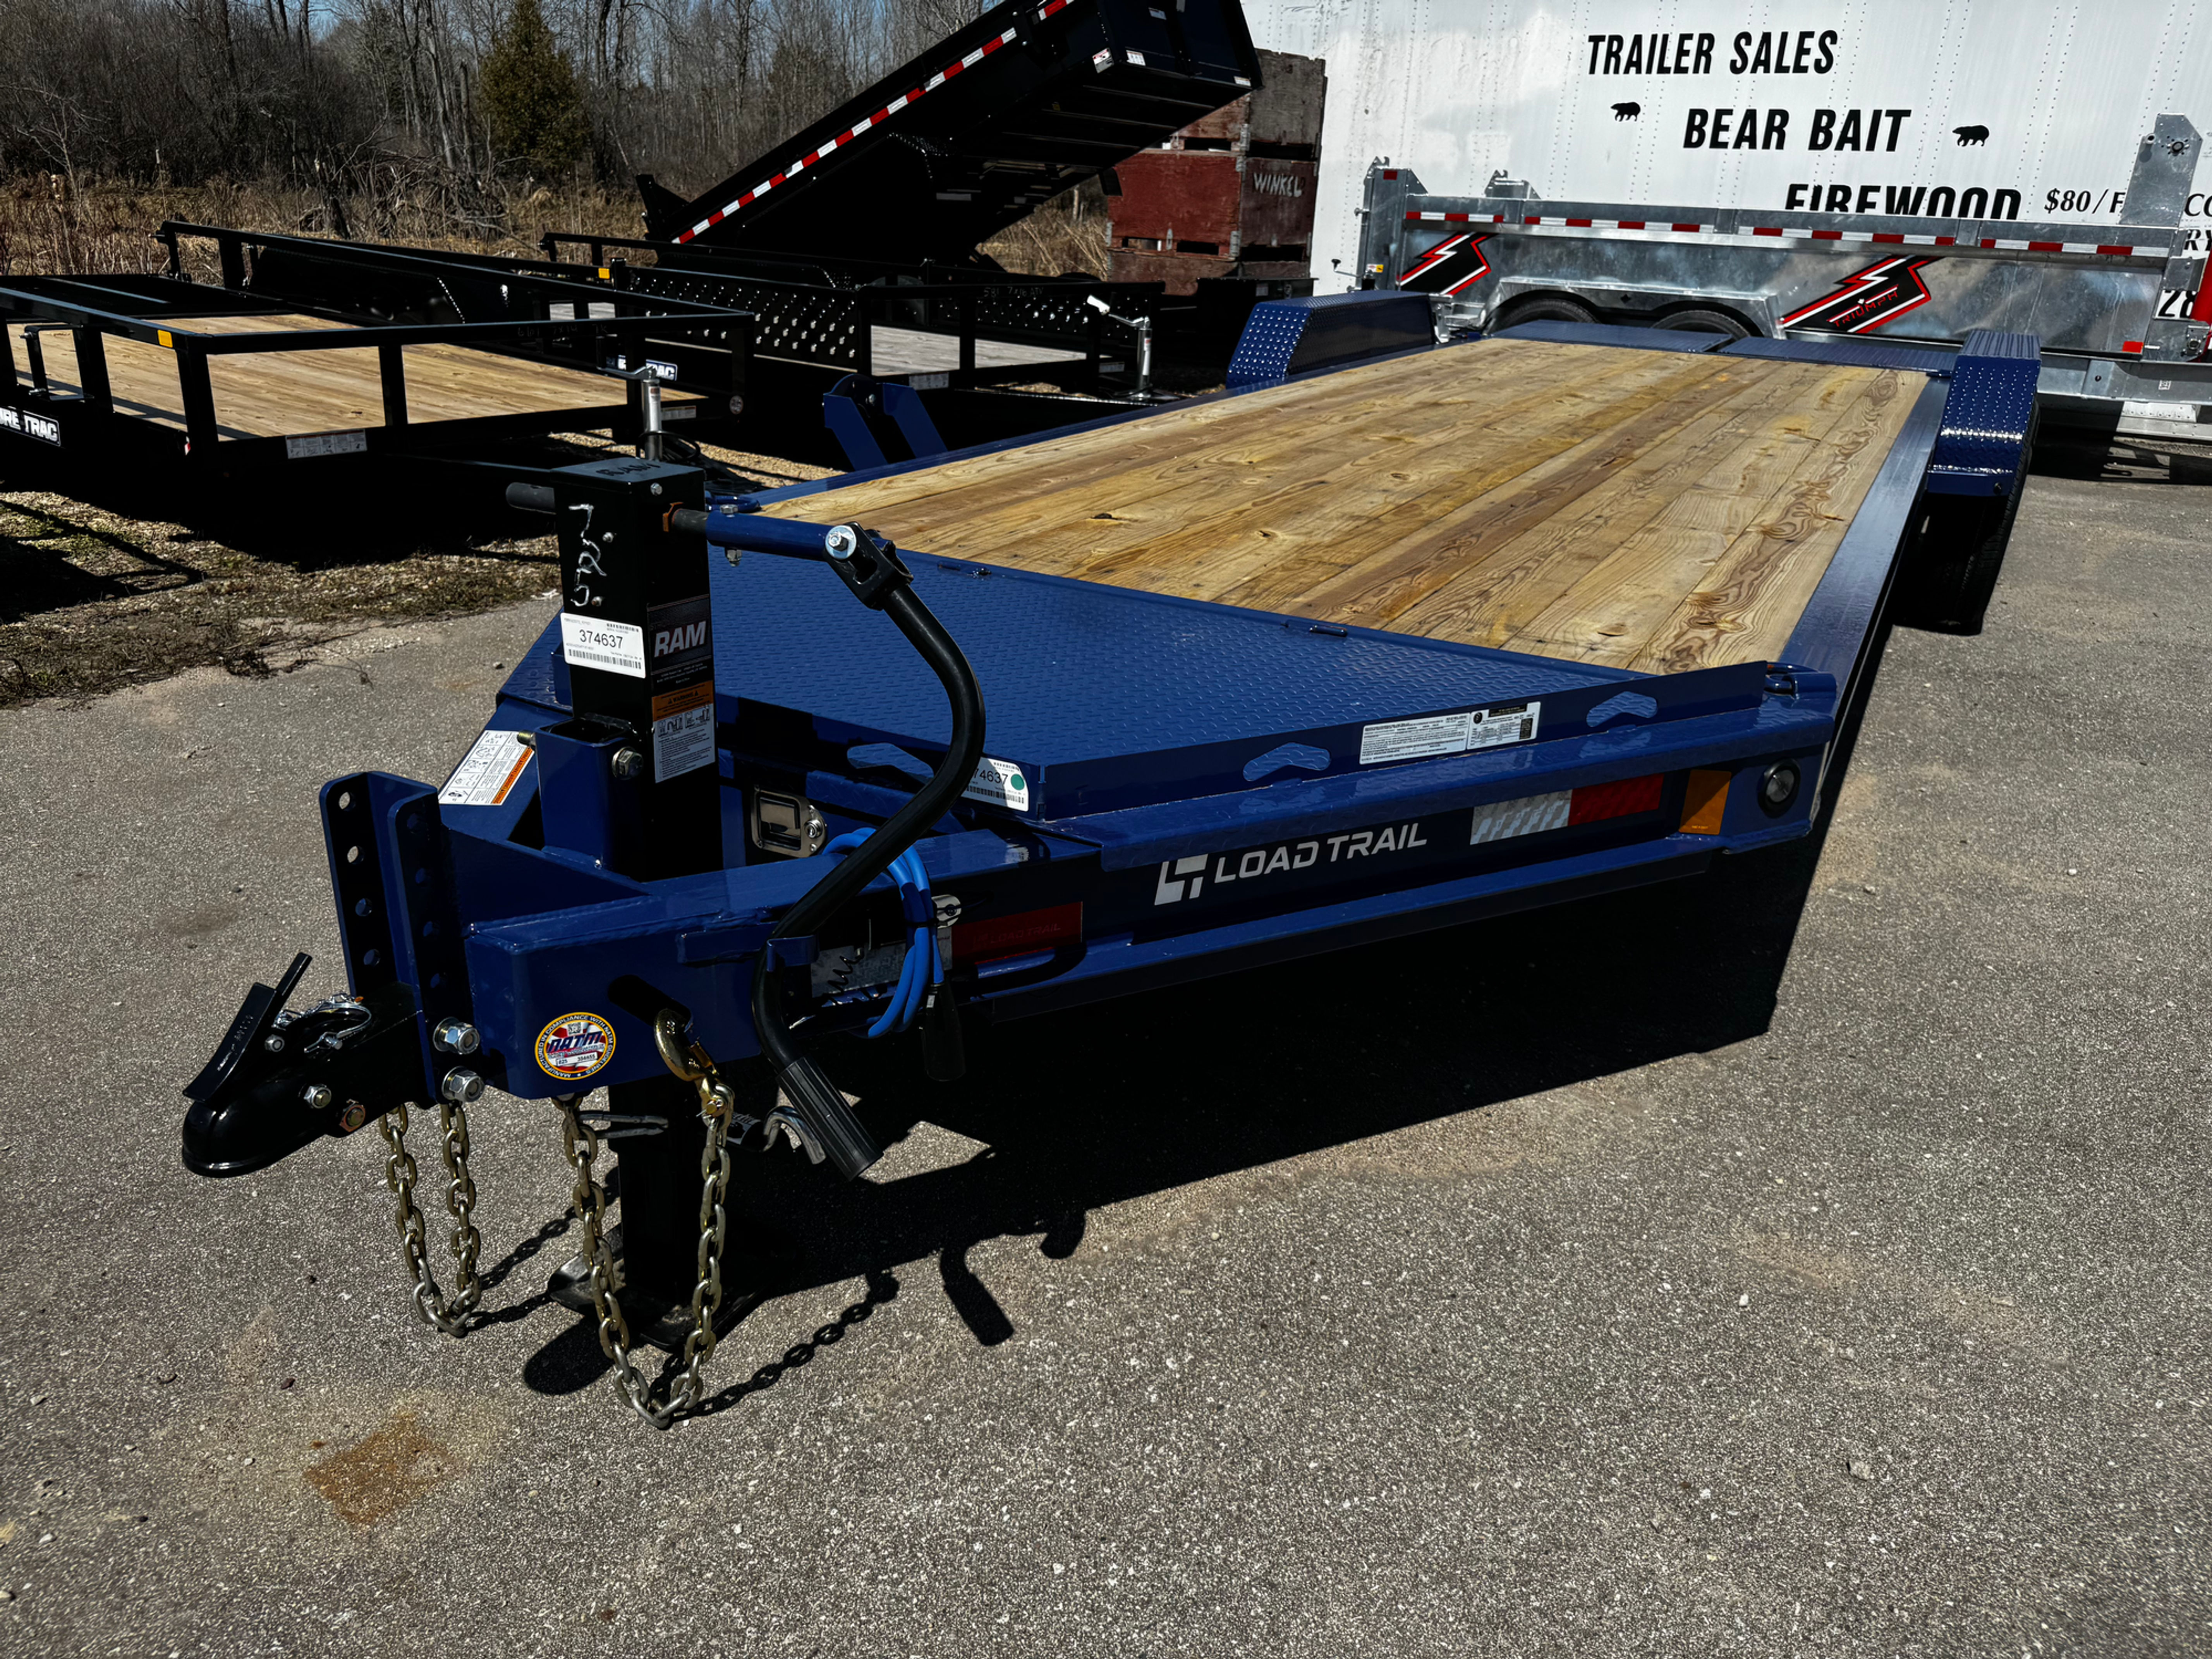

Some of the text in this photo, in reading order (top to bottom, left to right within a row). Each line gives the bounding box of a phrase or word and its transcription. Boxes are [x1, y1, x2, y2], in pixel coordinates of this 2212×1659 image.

[1587, 30, 1838, 75] TRAILER SALES
[1683, 108, 1911, 152] BEAR BAIT
[1254, 172, 1302, 198] WINKEL
[1785, 183, 2022, 220] FIREWOOD
[1833, 290, 1899, 328] TRIUMPH
[24, 415, 58, 442] TRAC
[579, 629, 623, 649] 374637
[654, 621, 706, 658] RAM
[1214, 842, 1319, 883] LOAD
[1328, 823, 1427, 862] TRAIL
[545, 1015, 589, 1035] COMPLIANCE
[590, 1017, 606, 1029] WITH
[547, 1031, 603, 1053] NATM
